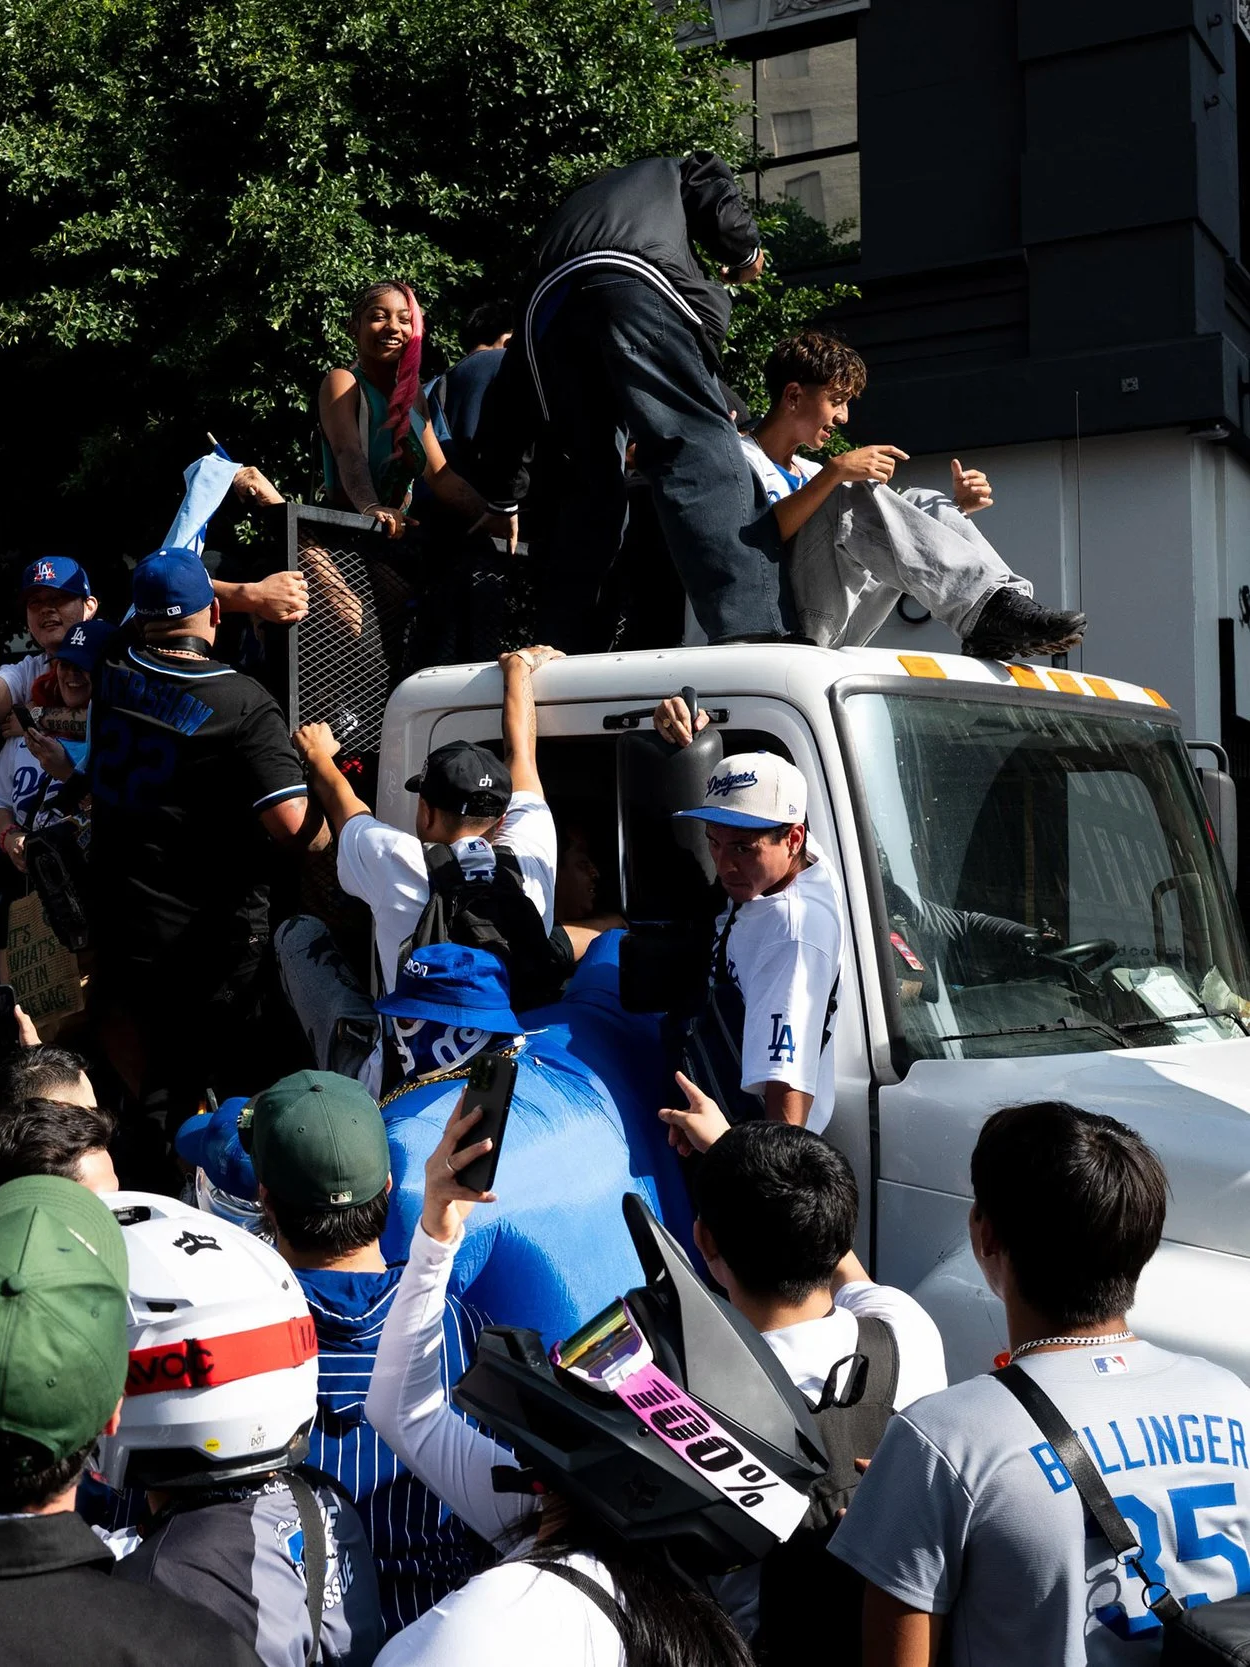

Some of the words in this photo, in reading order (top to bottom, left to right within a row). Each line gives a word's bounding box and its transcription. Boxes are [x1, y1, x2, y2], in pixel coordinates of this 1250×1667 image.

[35, 561, 54, 580] LA
[70, 627, 86, 646] LA
[101, 667, 214, 737] KERSHAW
[705, 770, 758, 798] Dodgers
[8, 934, 55, 973] WHAT'S
[36, 964, 50, 988] IN
[768, 1013, 795, 1063] LA
[626, 1379, 779, 1508] 100%
[1028, 1414, 1249, 1494] BLLINGER
